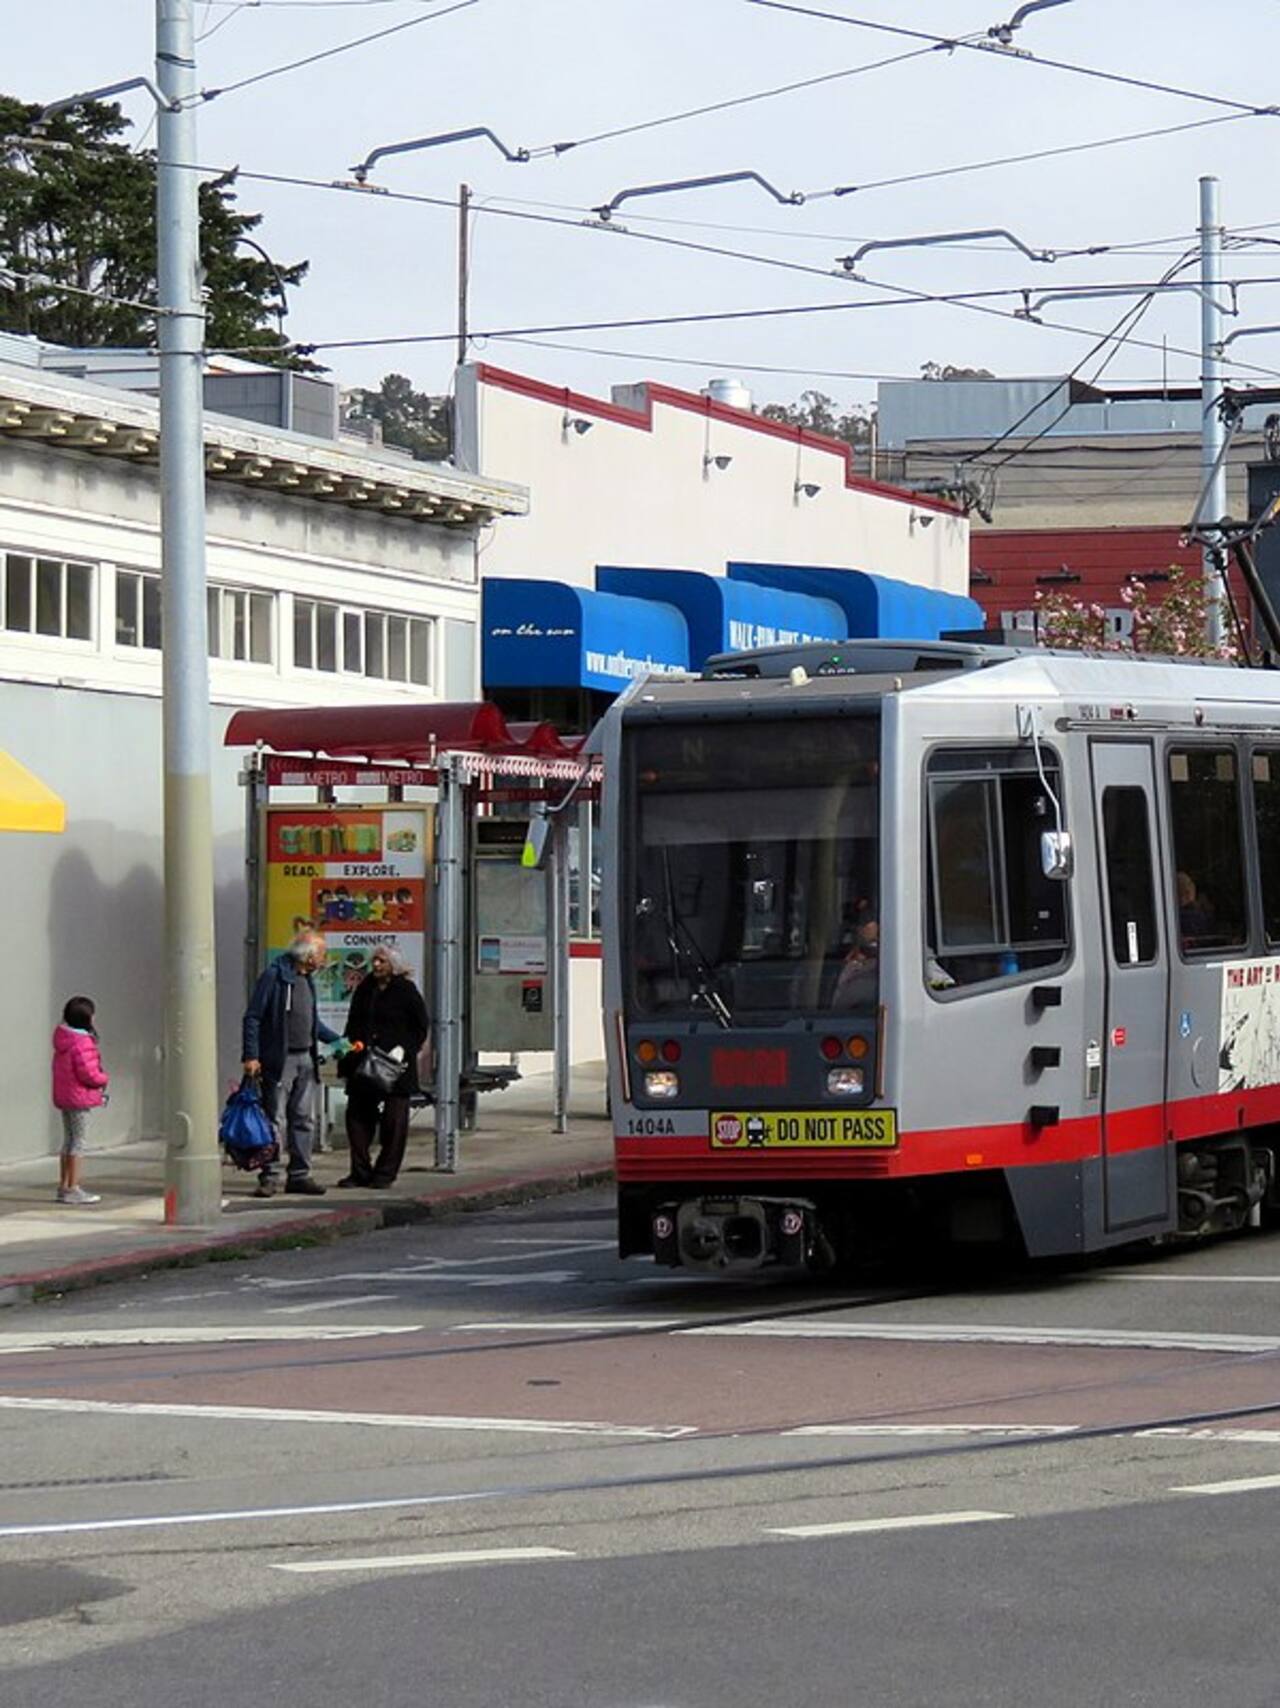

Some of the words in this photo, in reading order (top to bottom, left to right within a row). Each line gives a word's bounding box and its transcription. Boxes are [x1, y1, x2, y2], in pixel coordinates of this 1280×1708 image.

[307, 770, 348, 785] METRO
[382, 770, 424, 785] METRO
[283, 865, 319, 877] READ.
[343, 865, 400, 877] EXPLORE.
[1227, 968, 1244, 989] THE
[1247, 965, 1263, 986] ART
[628, 1118, 676, 1135] 1404A
[717, 1119, 741, 1140] STOP
[777, 1117, 800, 1141] DO
[805, 1117, 838, 1140] NOT
[842, 1117, 886, 1140] PASS
